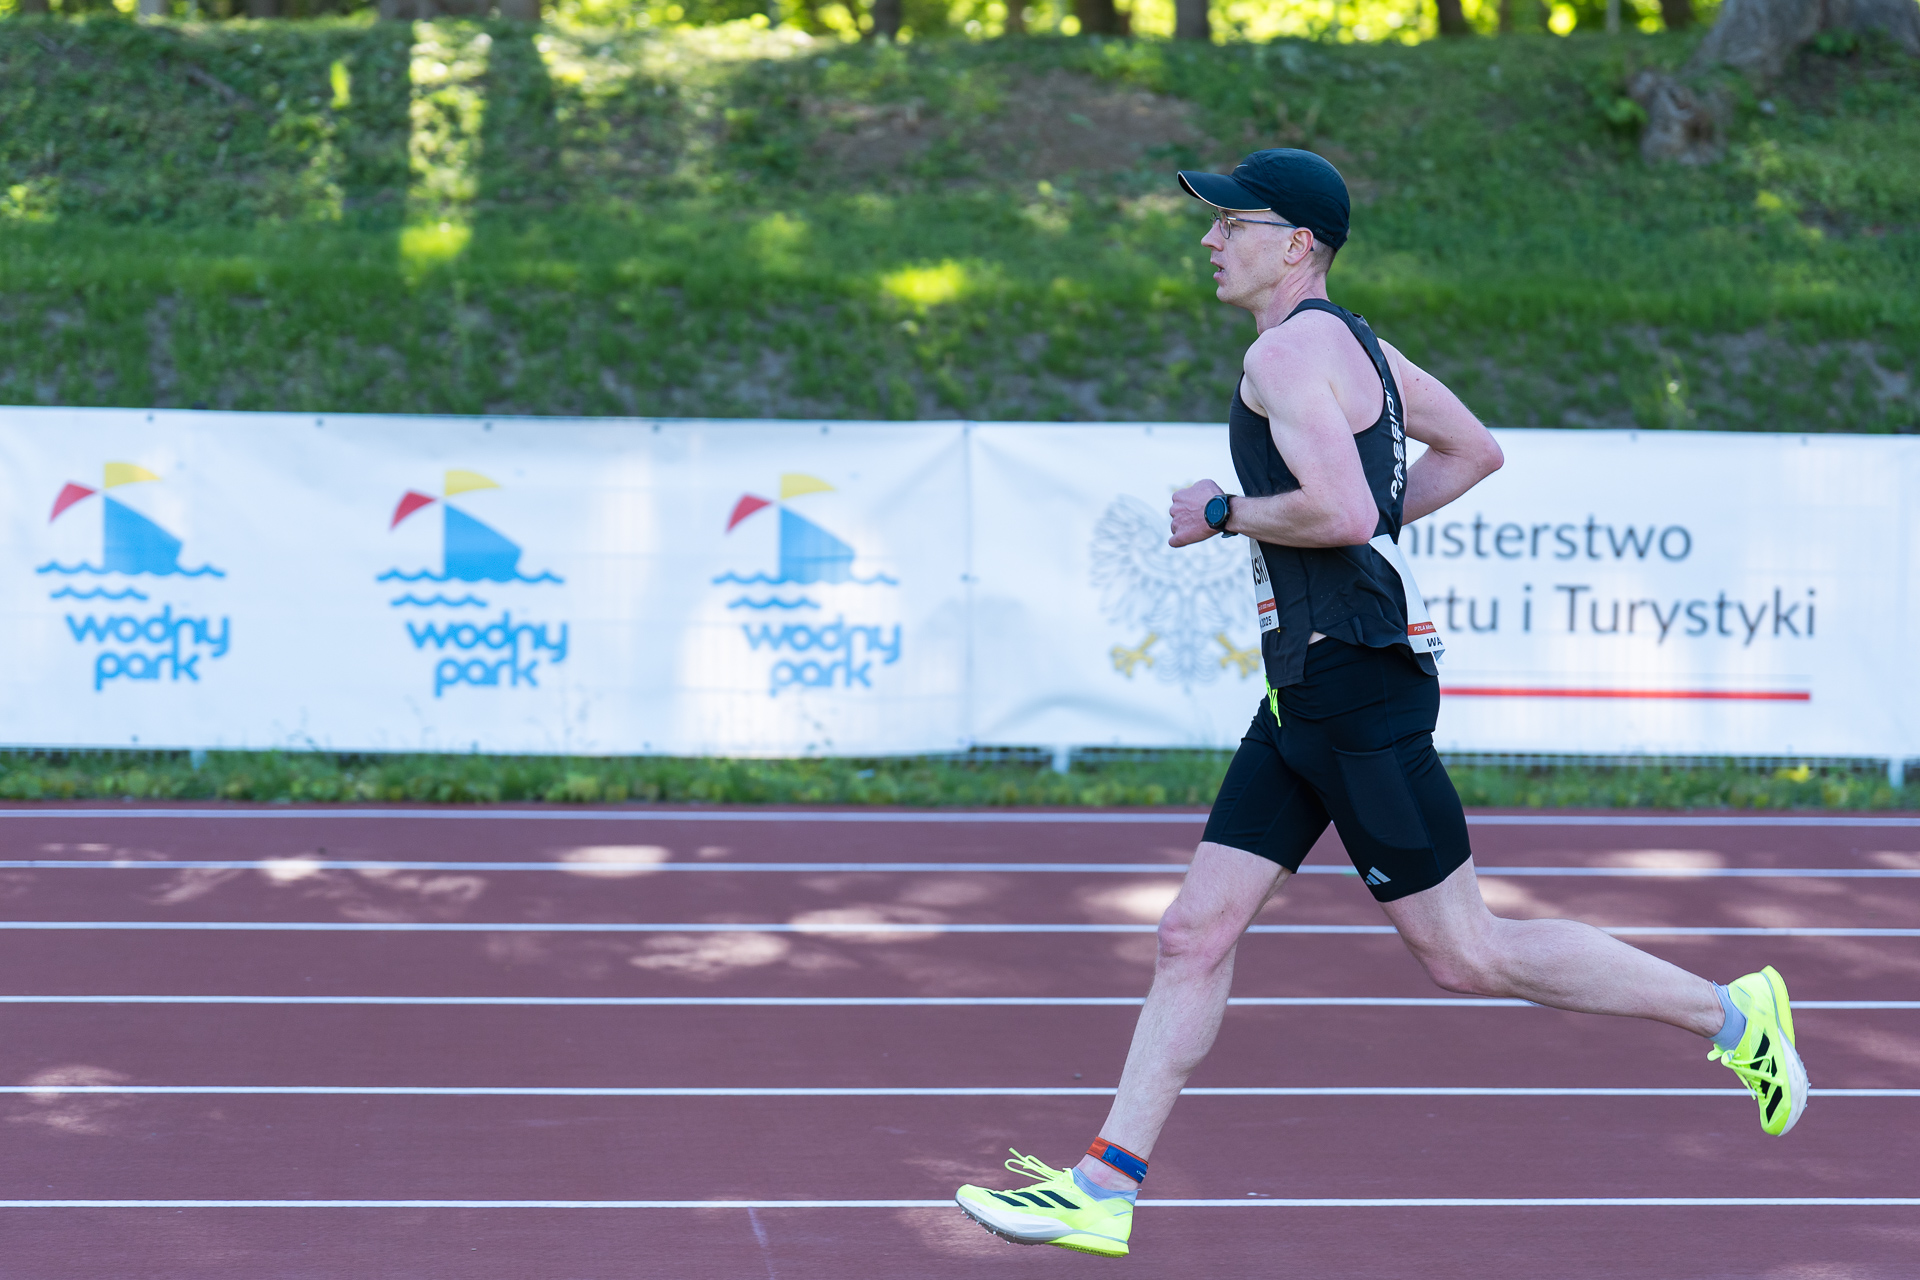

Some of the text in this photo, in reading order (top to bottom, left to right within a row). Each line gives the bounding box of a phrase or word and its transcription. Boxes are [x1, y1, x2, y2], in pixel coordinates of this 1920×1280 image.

[1402, 510, 1692, 562] nisterstwo
[64, 604, 230, 659] wodny
[405, 610, 568, 665] wodny
[742, 613, 903, 666] wodny
[1523, 584, 1532, 633] i
[1554, 584, 1816, 647] Turystyki
[1426, 636, 1443, 648] WA
[94, 651, 200, 693] park
[435, 657, 539, 699] park
[769, 659, 873, 699] park
